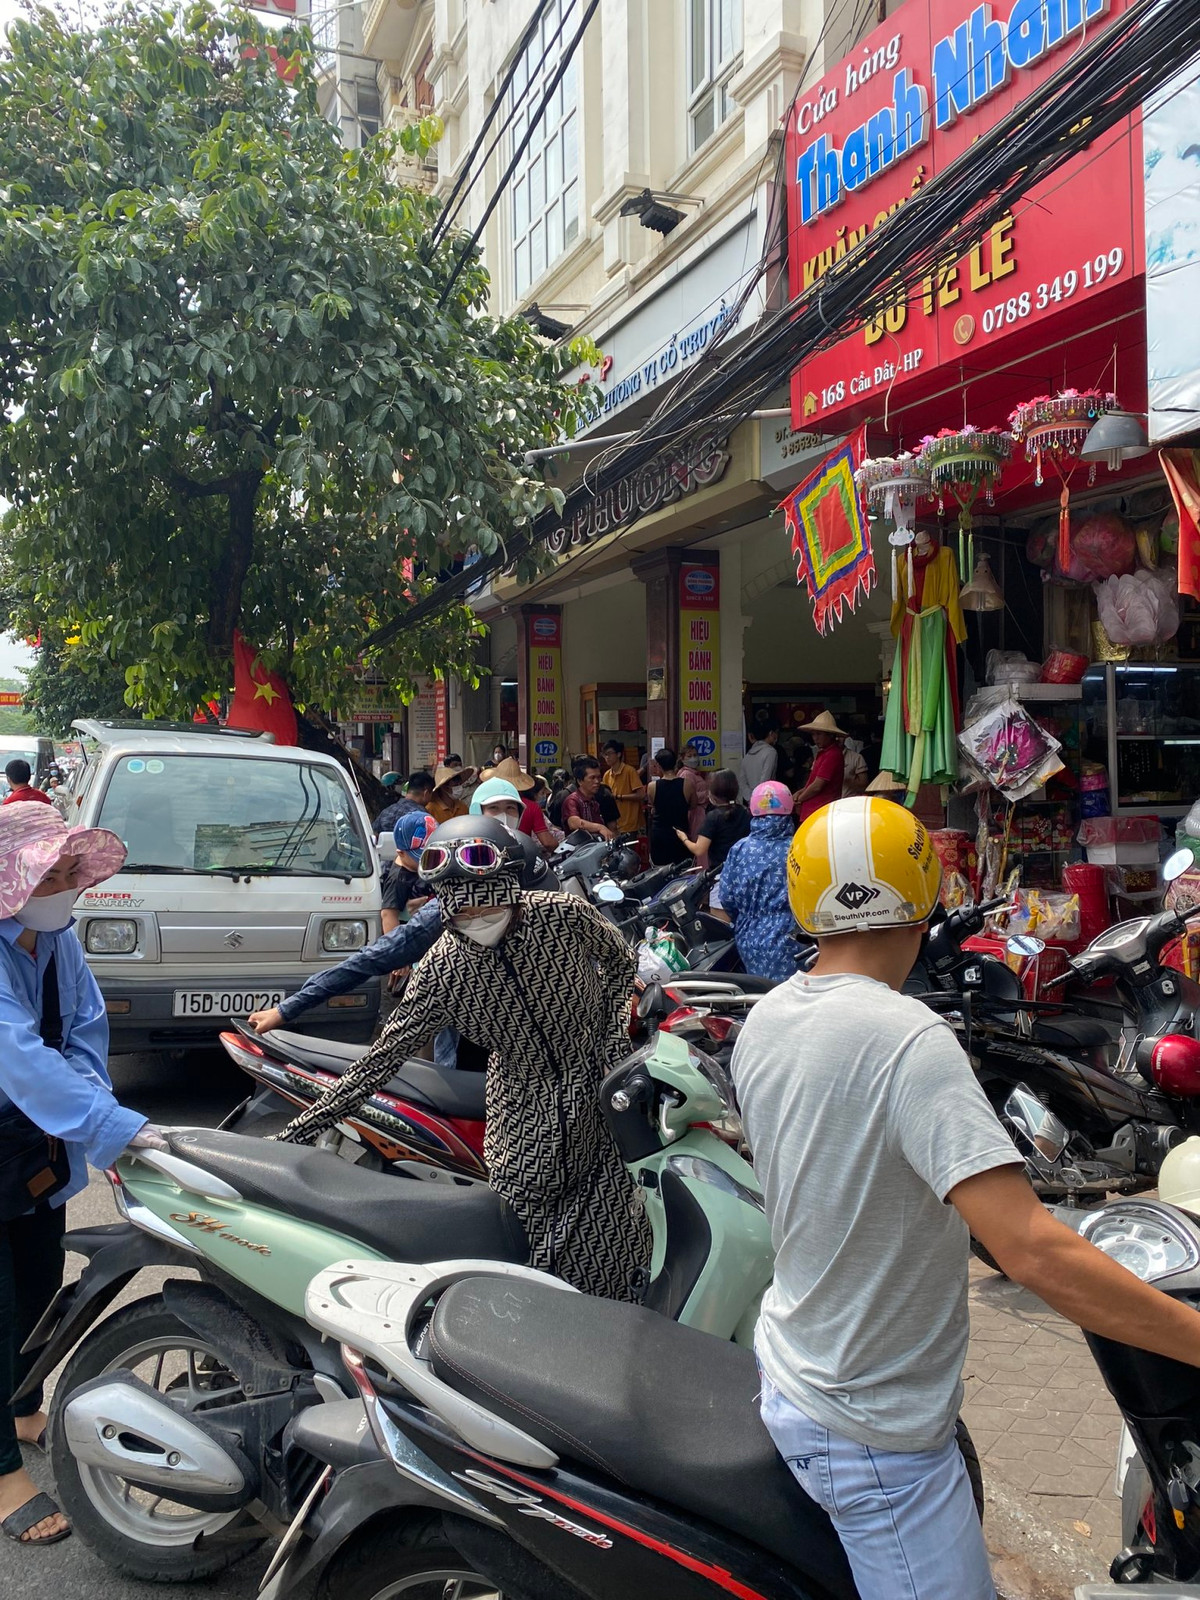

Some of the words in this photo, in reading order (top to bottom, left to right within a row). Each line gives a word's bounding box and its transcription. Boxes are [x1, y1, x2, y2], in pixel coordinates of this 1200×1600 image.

[797, 86, 838, 135] Cửa
[845, 33, 903, 97] hàng
[796, 67, 929, 226] Thanh
[982, 291, 1031, 333] 0788
[1036, 270, 1078, 309] 349
[1082, 247, 1124, 288] 199
[821, 380, 845, 409] 168
[850, 371, 871, 395] Cầu
[874, 359, 894, 385] Đất
[904, 348, 923, 372] HP
[690, 617, 709, 644] HIỆU
[689, 648, 711, 670] BÁNH
[689, 677, 711, 701] ĐÔNG
[683, 709, 717, 731] PHƯƠNG
[539, 744, 554, 754] 172
[83, 899, 145, 907] CARRY
[846, 891, 863, 900] VP
[834, 909, 890, 921] SieuthiVP.com
